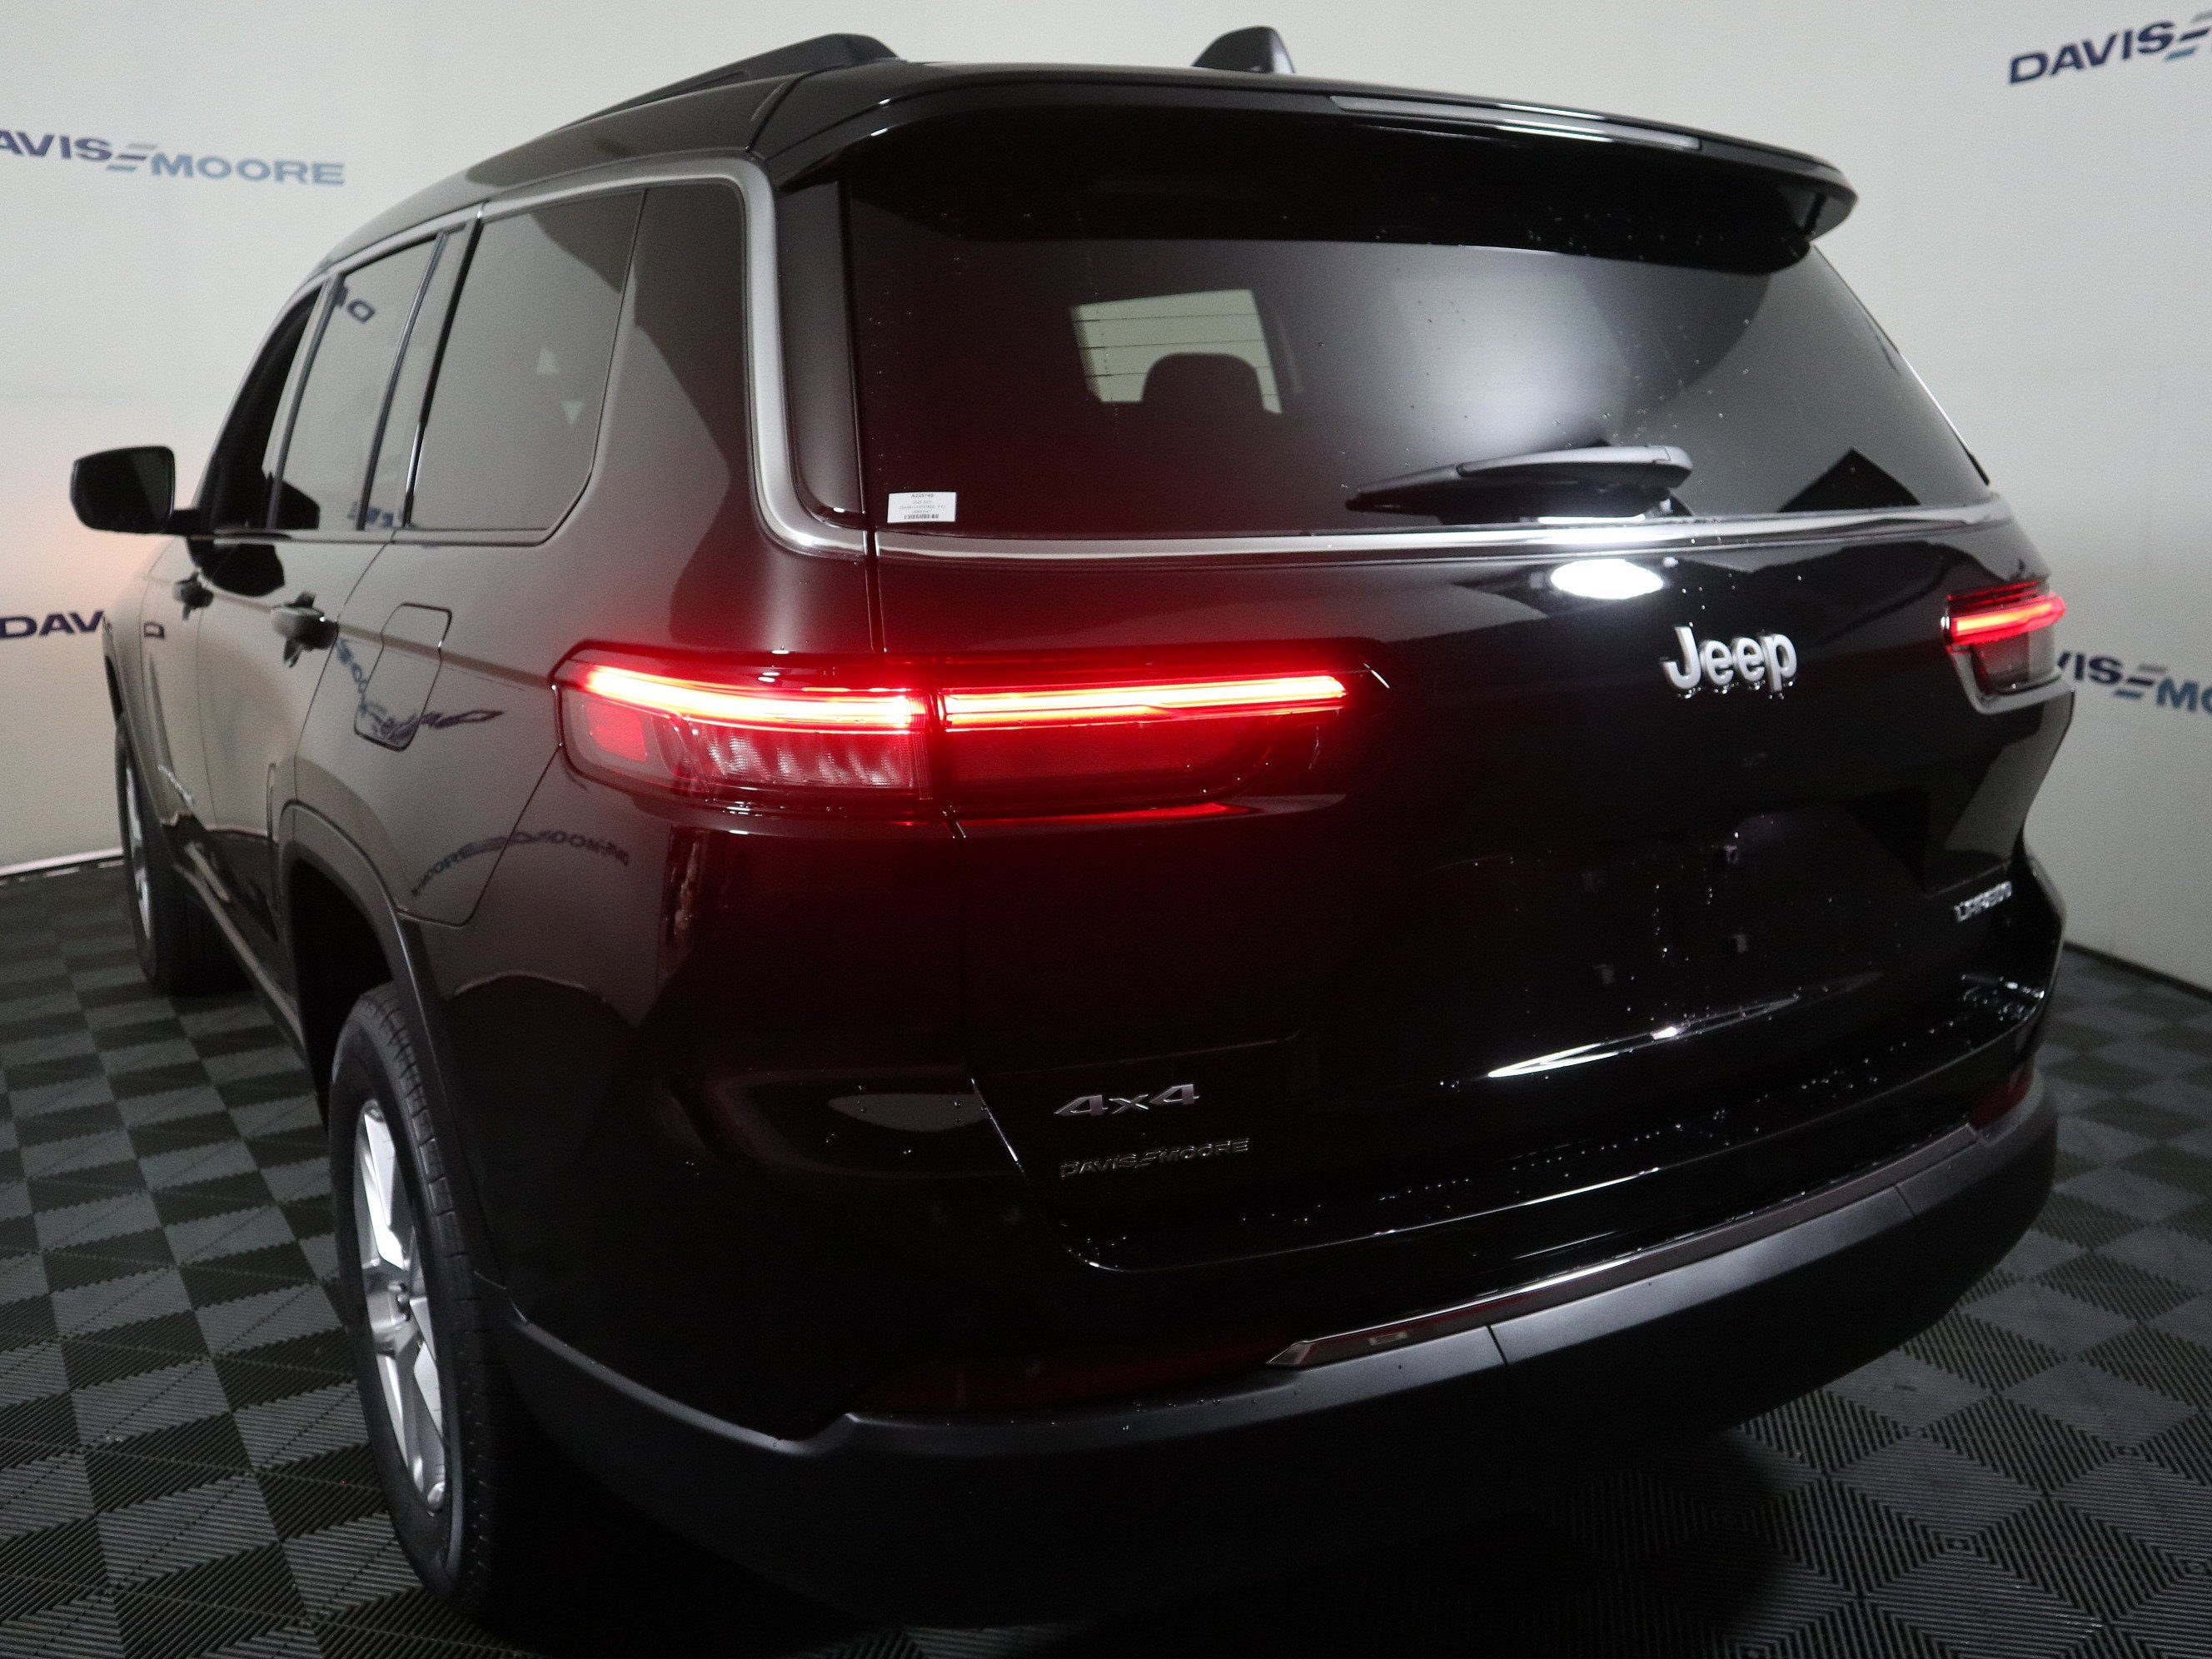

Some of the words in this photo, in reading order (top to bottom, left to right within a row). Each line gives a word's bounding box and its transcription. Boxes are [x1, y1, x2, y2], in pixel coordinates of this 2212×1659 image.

[2009, 20, 2175, 84] DAVIS
[150, 152, 345, 186] MOORE
[1660, 626, 1797, 693] Jeep
